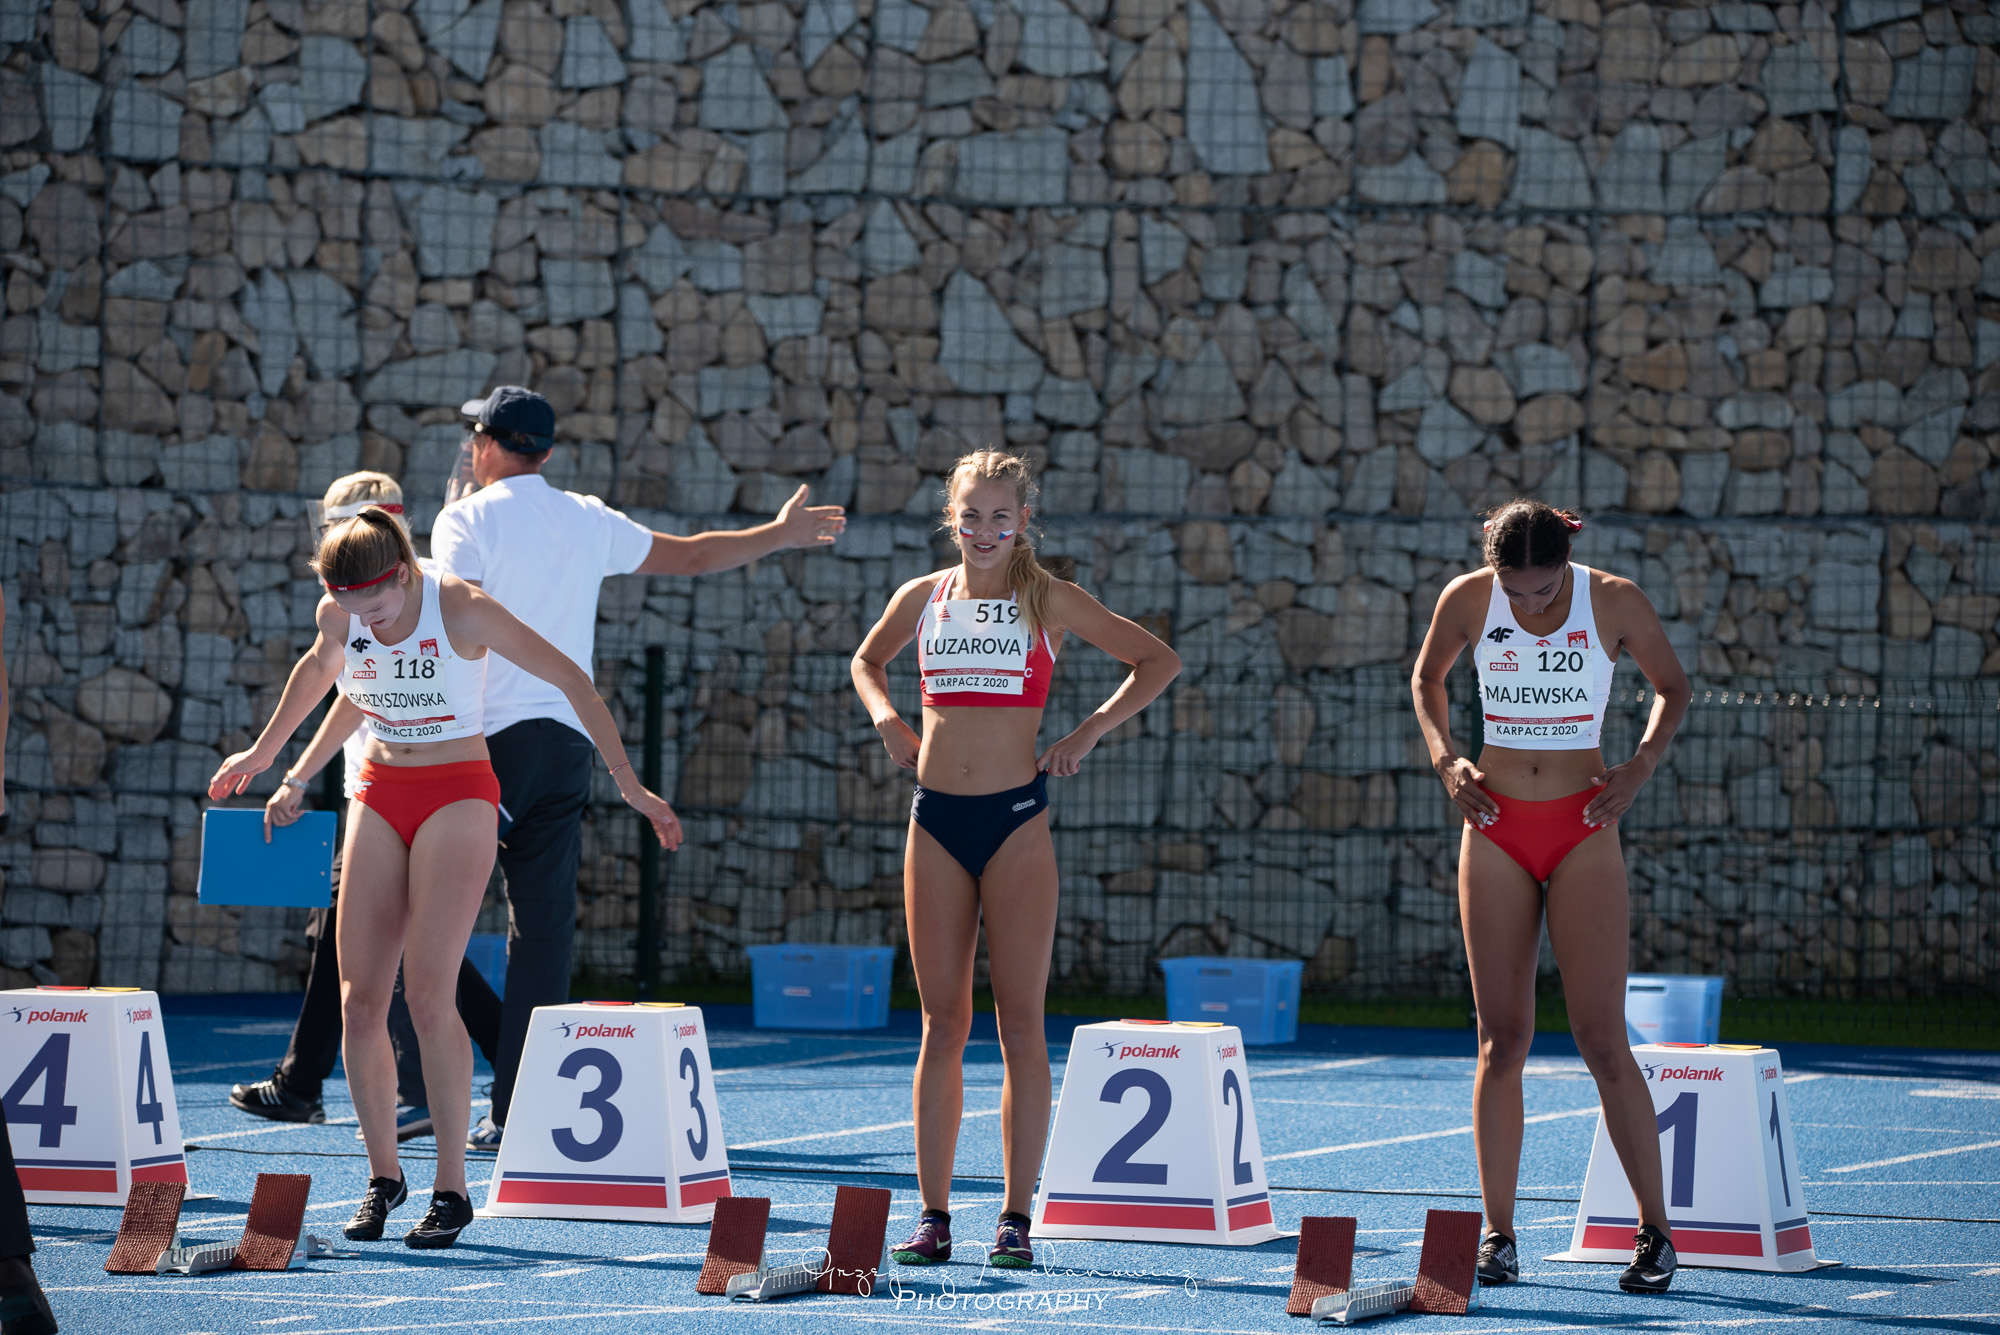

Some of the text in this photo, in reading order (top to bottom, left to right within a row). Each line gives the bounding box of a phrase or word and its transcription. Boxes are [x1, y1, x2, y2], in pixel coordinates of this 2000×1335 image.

[975, 603, 1020, 625] 519
[1487, 626, 1515, 644] 4F
[351, 636, 372, 653] 4F
[926, 638, 1022, 656] LUZAROVA
[394, 658, 436, 679] 118
[1490, 663, 1518, 671] ORLEN
[1537, 651, 1584, 672] 120
[353, 671, 376, 679] ORLEN
[935, 677, 1009, 688] KARPACZ 2020
[1485, 685, 1588, 704] MAJEWSKA
[373, 720, 415, 737] KARPACZ
[416, 724, 442, 737] 2020
[1496, 725, 1578, 737] KARPACZ 2020
[27, 1008, 89, 1025] polanik
[132, 1006, 153, 1024] polanik
[575, 1023, 636, 1040] polanik
[679, 1022, 698, 1040] polanik
[1119, 1043, 1182, 1060] polanik
[1222, 1042, 1238, 1061] polanik
[1660, 1065, 1725, 1082] polanik
[0, 1032, 78, 1148] 4
[136, 1031, 164, 1145] 4
[551, 1047, 624, 1163] 3
[679, 1047, 708, 1162] 3
[1091, 1068, 1172, 1185] 2
[1222, 1069, 1253, 1186] 2
[1656, 1092, 1699, 1208] 1
[1769, 1091, 1791, 1207] 1
